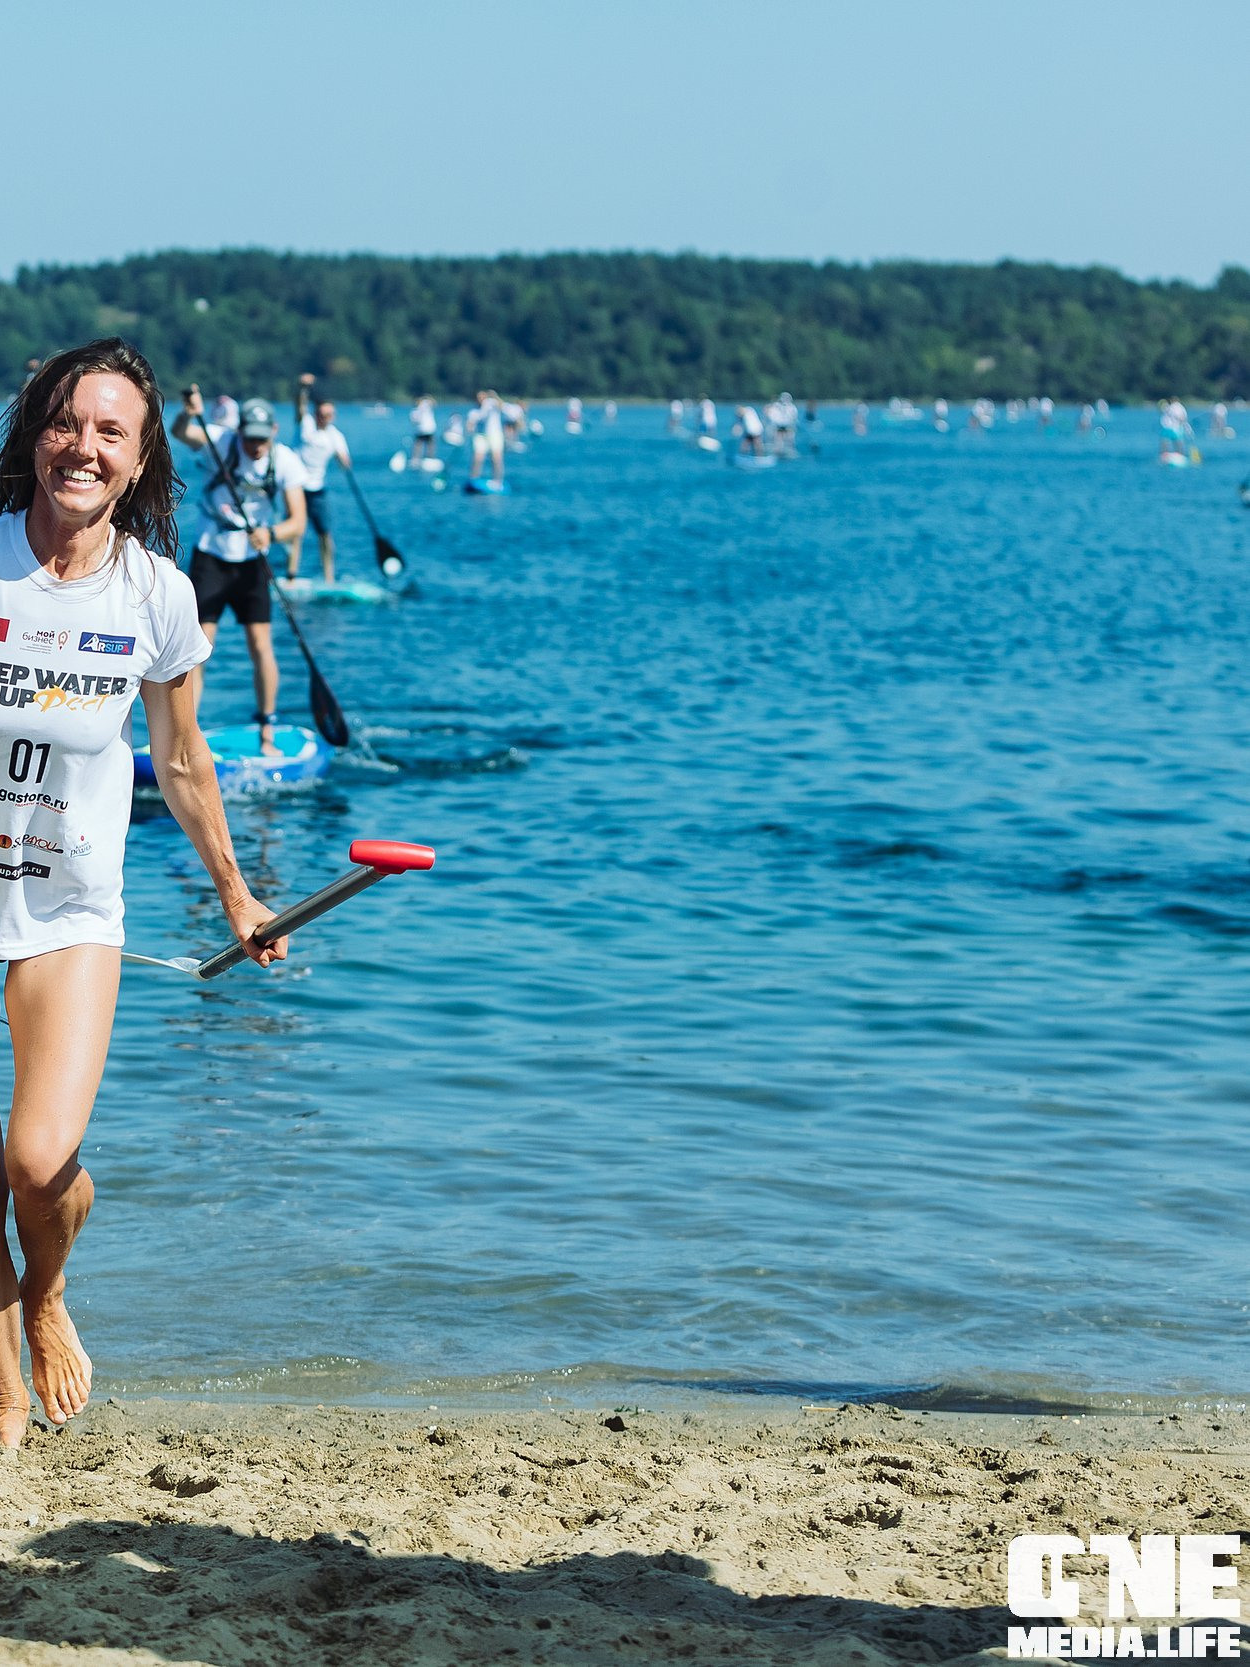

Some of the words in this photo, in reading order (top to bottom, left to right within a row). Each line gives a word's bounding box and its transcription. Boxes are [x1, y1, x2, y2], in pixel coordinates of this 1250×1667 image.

[22, 632, 54, 645] бизнес
[36, 630, 55, 639] мой
[34, 667, 128, 697] WATER
[8, 738, 52, 784] 01
